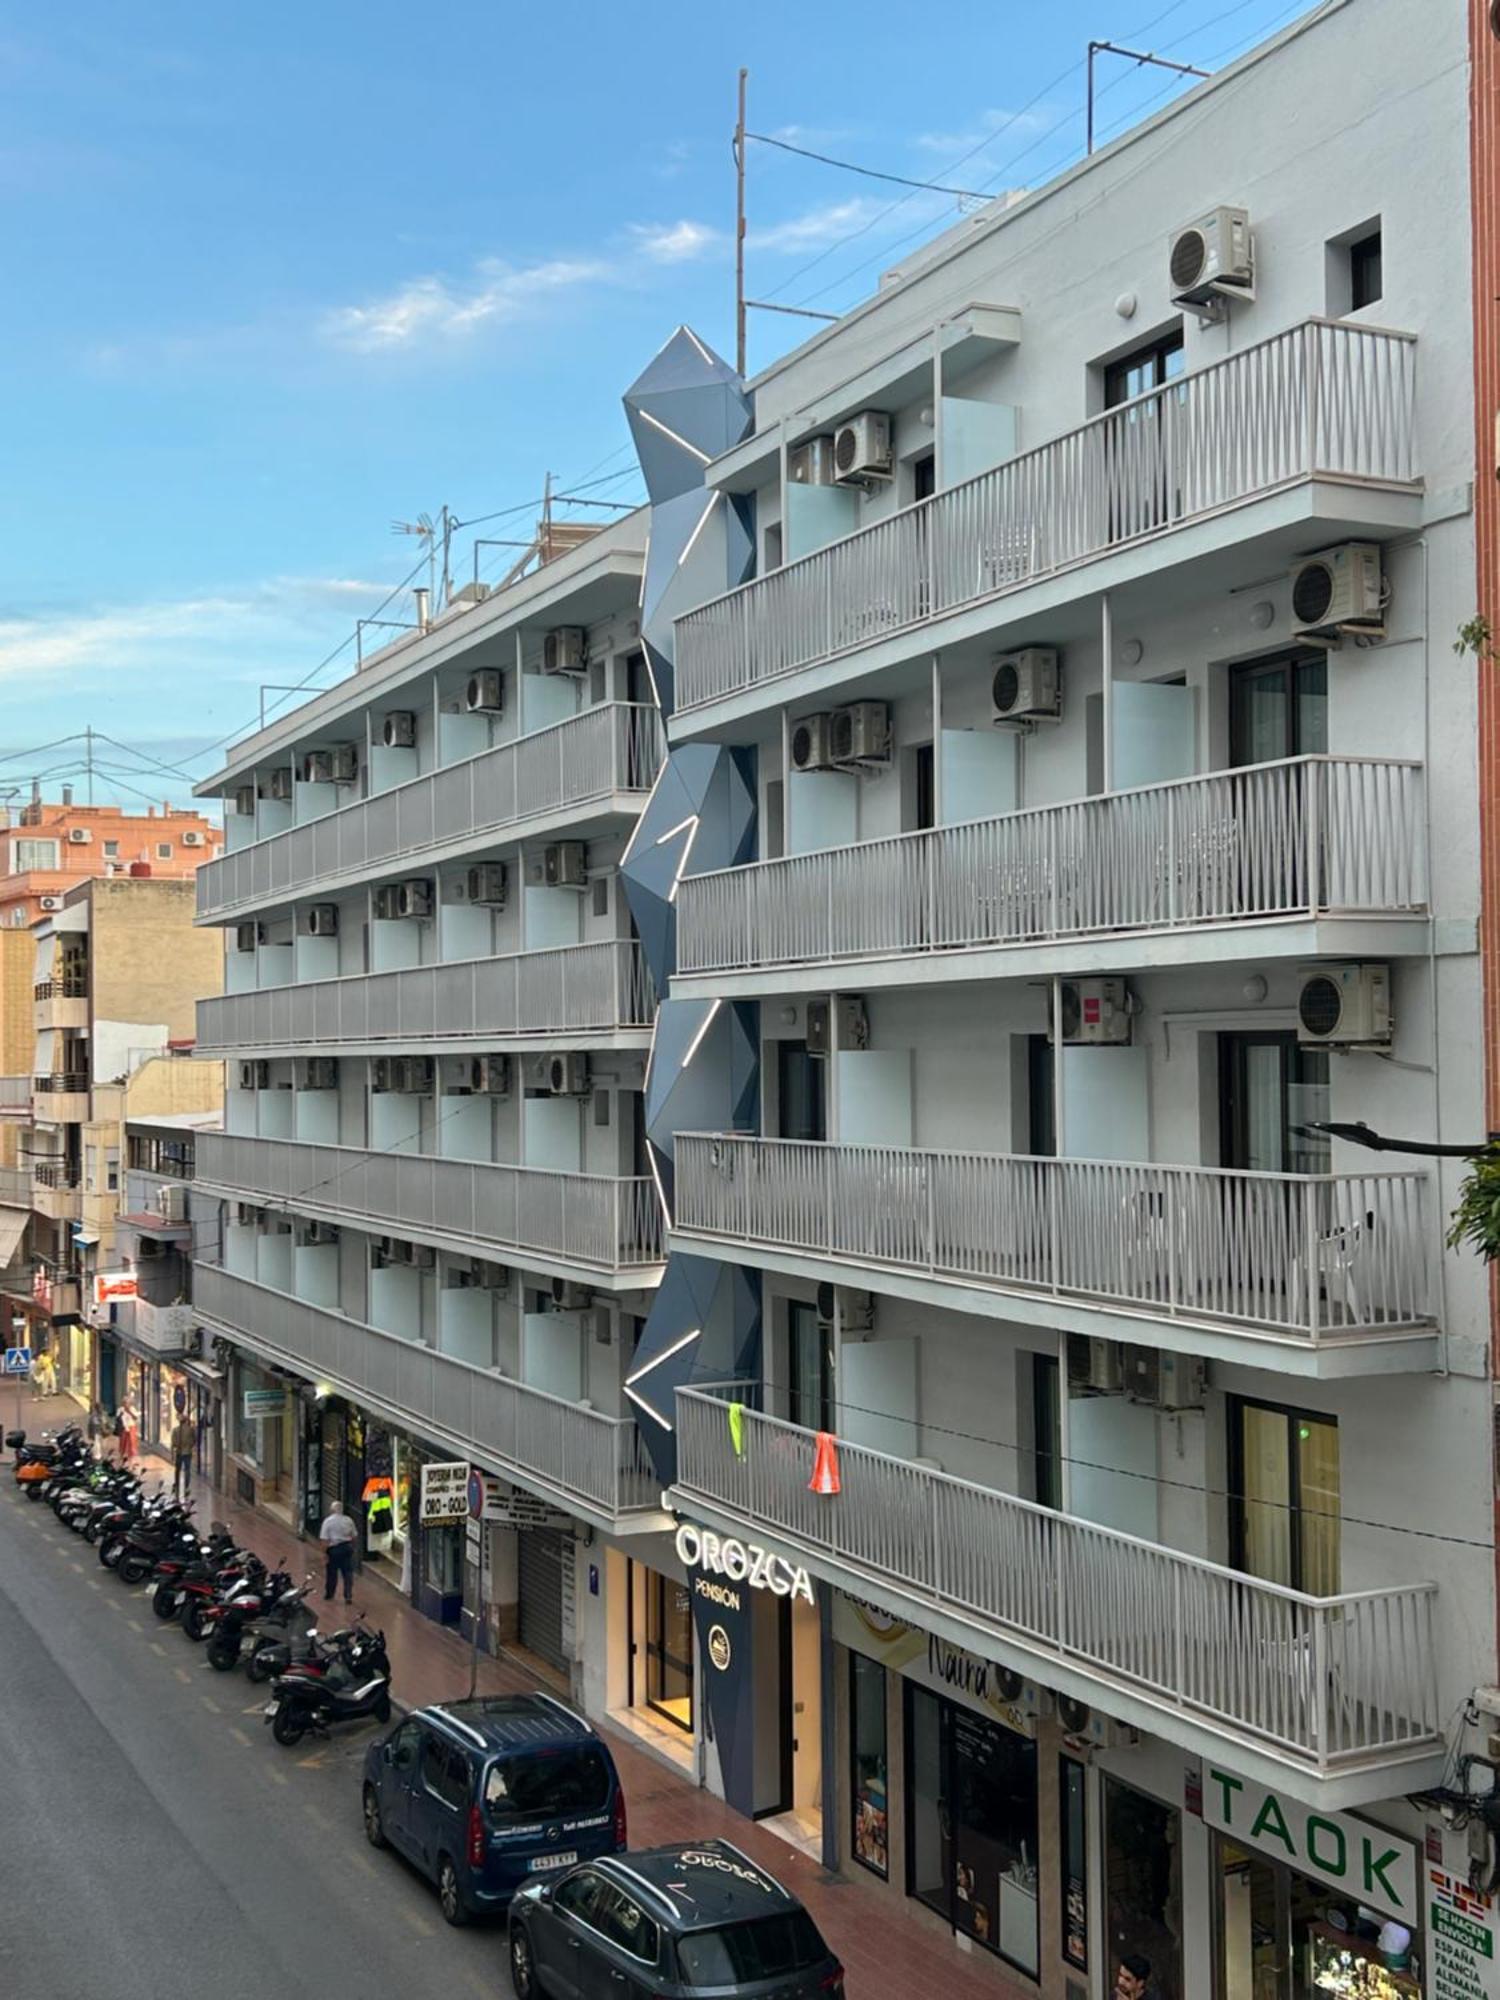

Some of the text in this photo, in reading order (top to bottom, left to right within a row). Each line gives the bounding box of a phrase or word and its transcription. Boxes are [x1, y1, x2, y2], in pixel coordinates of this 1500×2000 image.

[426, 1497, 441, 1515] ORO
[448, 1496, 467, 1514] GOLD
[928, 1633, 990, 1698] Naira
[1210, 1769, 1403, 1908] TAOK
[1450, 1914, 1486, 1940] HACEN
[1435, 1938, 1476, 1968] ESPAÑA
[1435, 1952, 1480, 1984] FRANCIA
[1436, 1967, 1489, 2000] ALEMANIA
